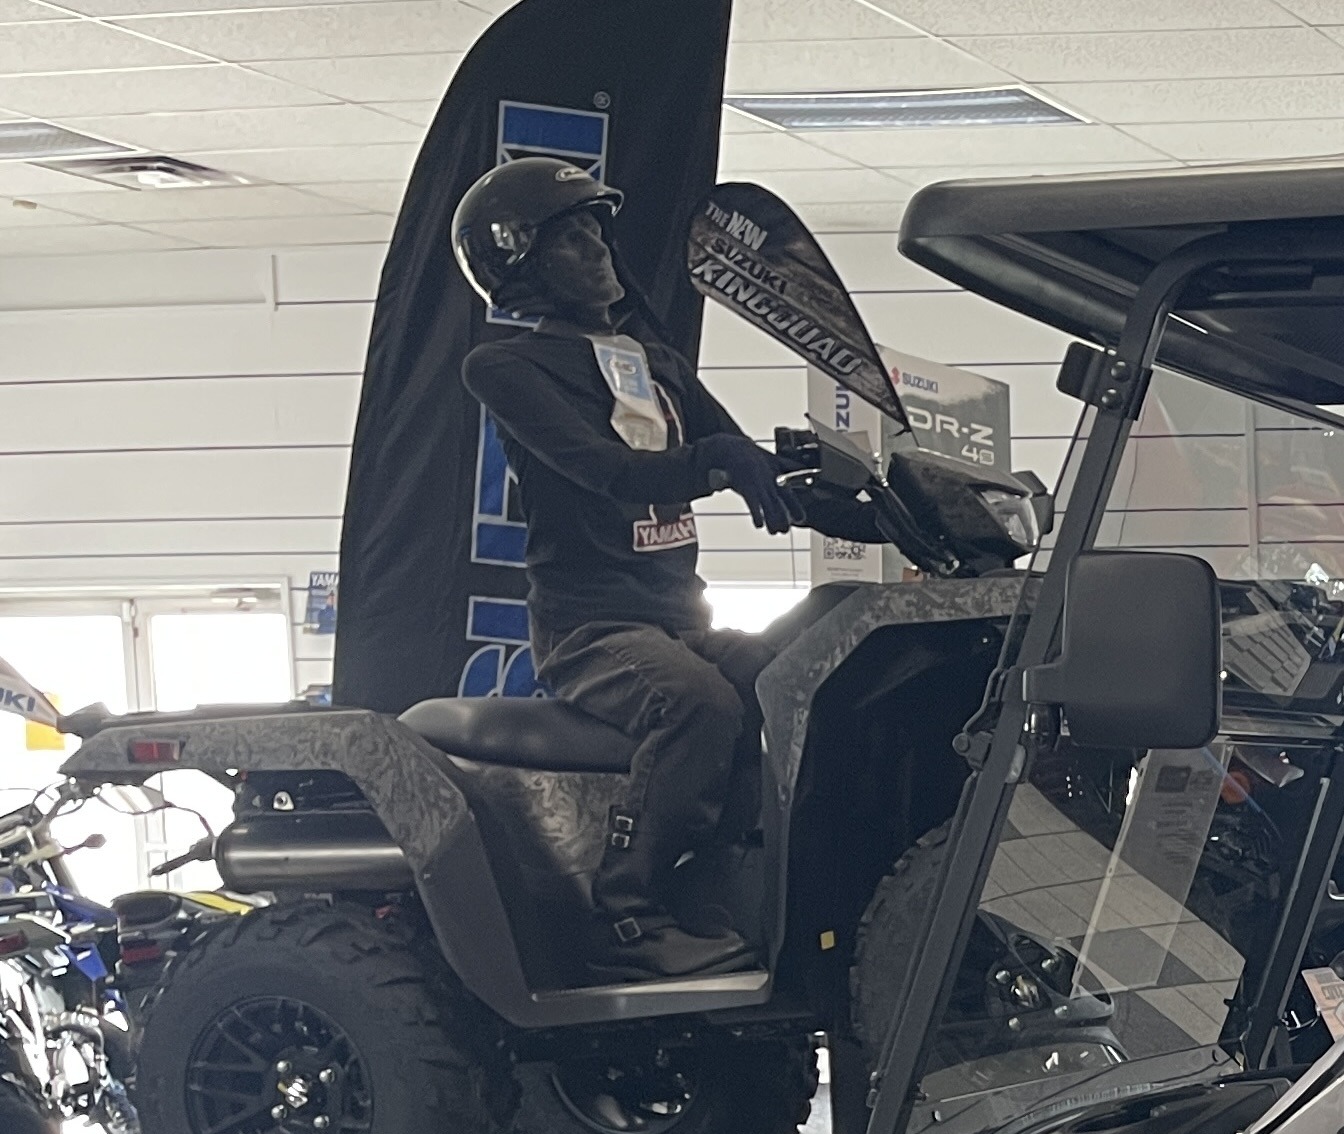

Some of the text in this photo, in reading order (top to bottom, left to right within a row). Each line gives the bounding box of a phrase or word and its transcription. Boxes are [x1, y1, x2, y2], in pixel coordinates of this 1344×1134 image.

[726, 211, 768, 251] NEW
[711, 238, 788, 295] SUZUKI
[692, 259, 862, 375] KINGQUAD
[902, 372, 938, 394] SUZUKI
[906, 405, 994, 446] DR-Z
[638, 519, 697, 546] YAMAH
